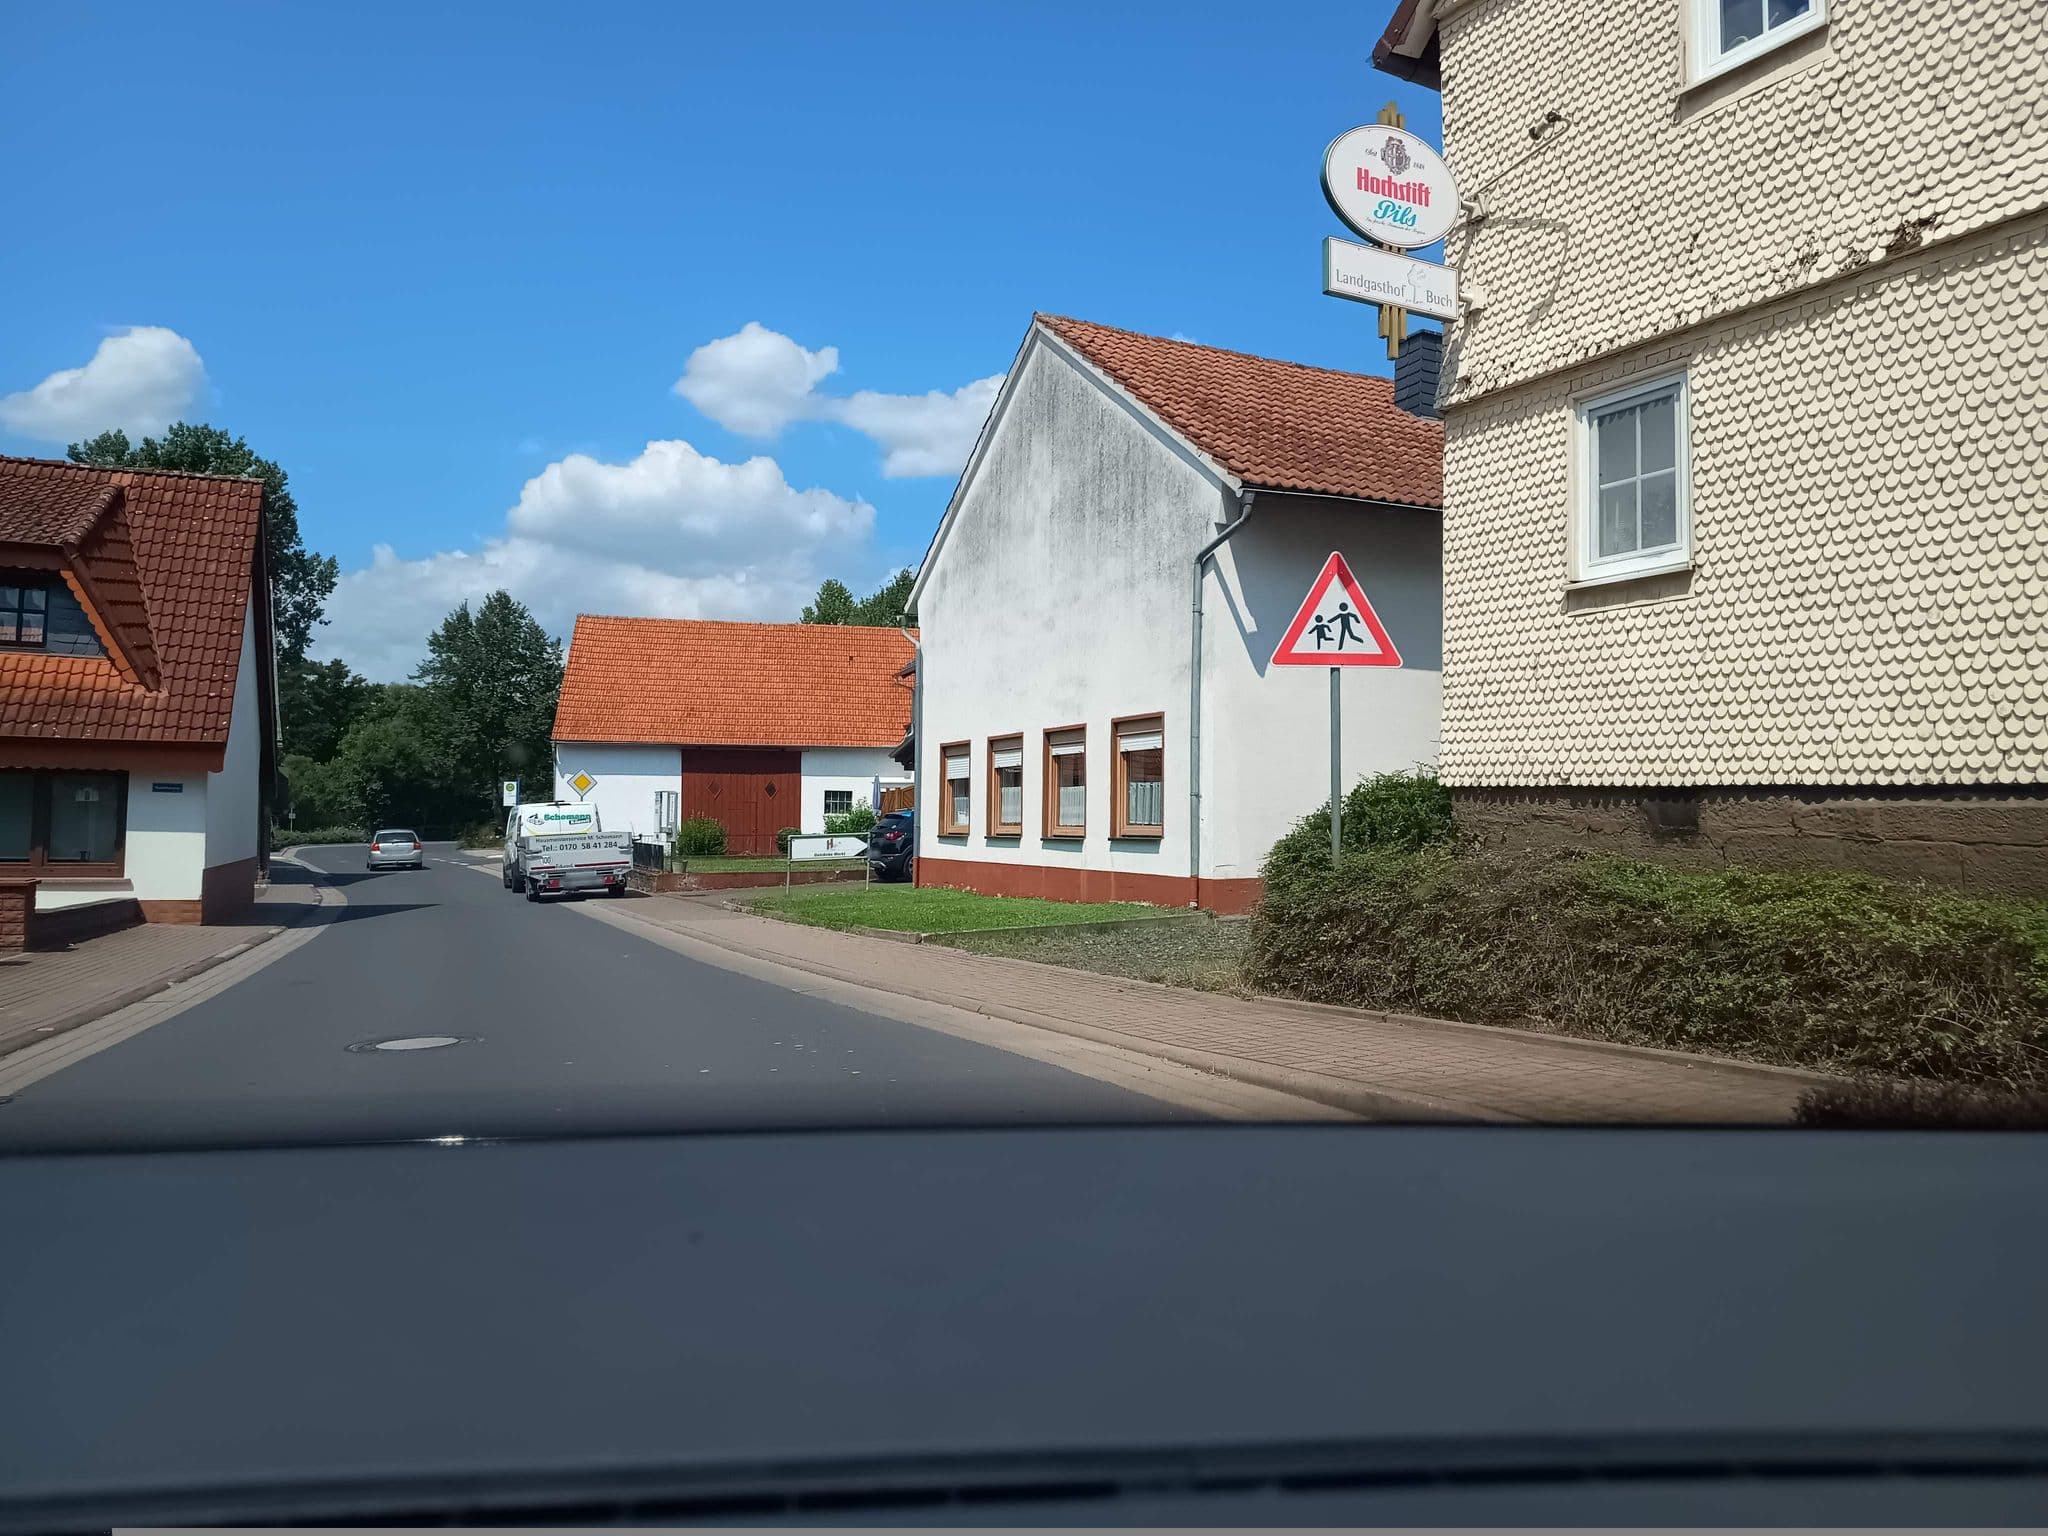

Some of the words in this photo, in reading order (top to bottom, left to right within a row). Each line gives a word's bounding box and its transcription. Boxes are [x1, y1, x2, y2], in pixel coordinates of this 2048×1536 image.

[1357, 167, 1431, 207] Hochstift
[1374, 200, 1417, 226] Pils
[1336, 268, 1406, 298] Landgasthof
[1426, 290, 1453, 308] Buch
[544, 813, 591, 821] Schomann
[559, 843, 578, 851] 0170
[581, 842, 591, 850] 58
